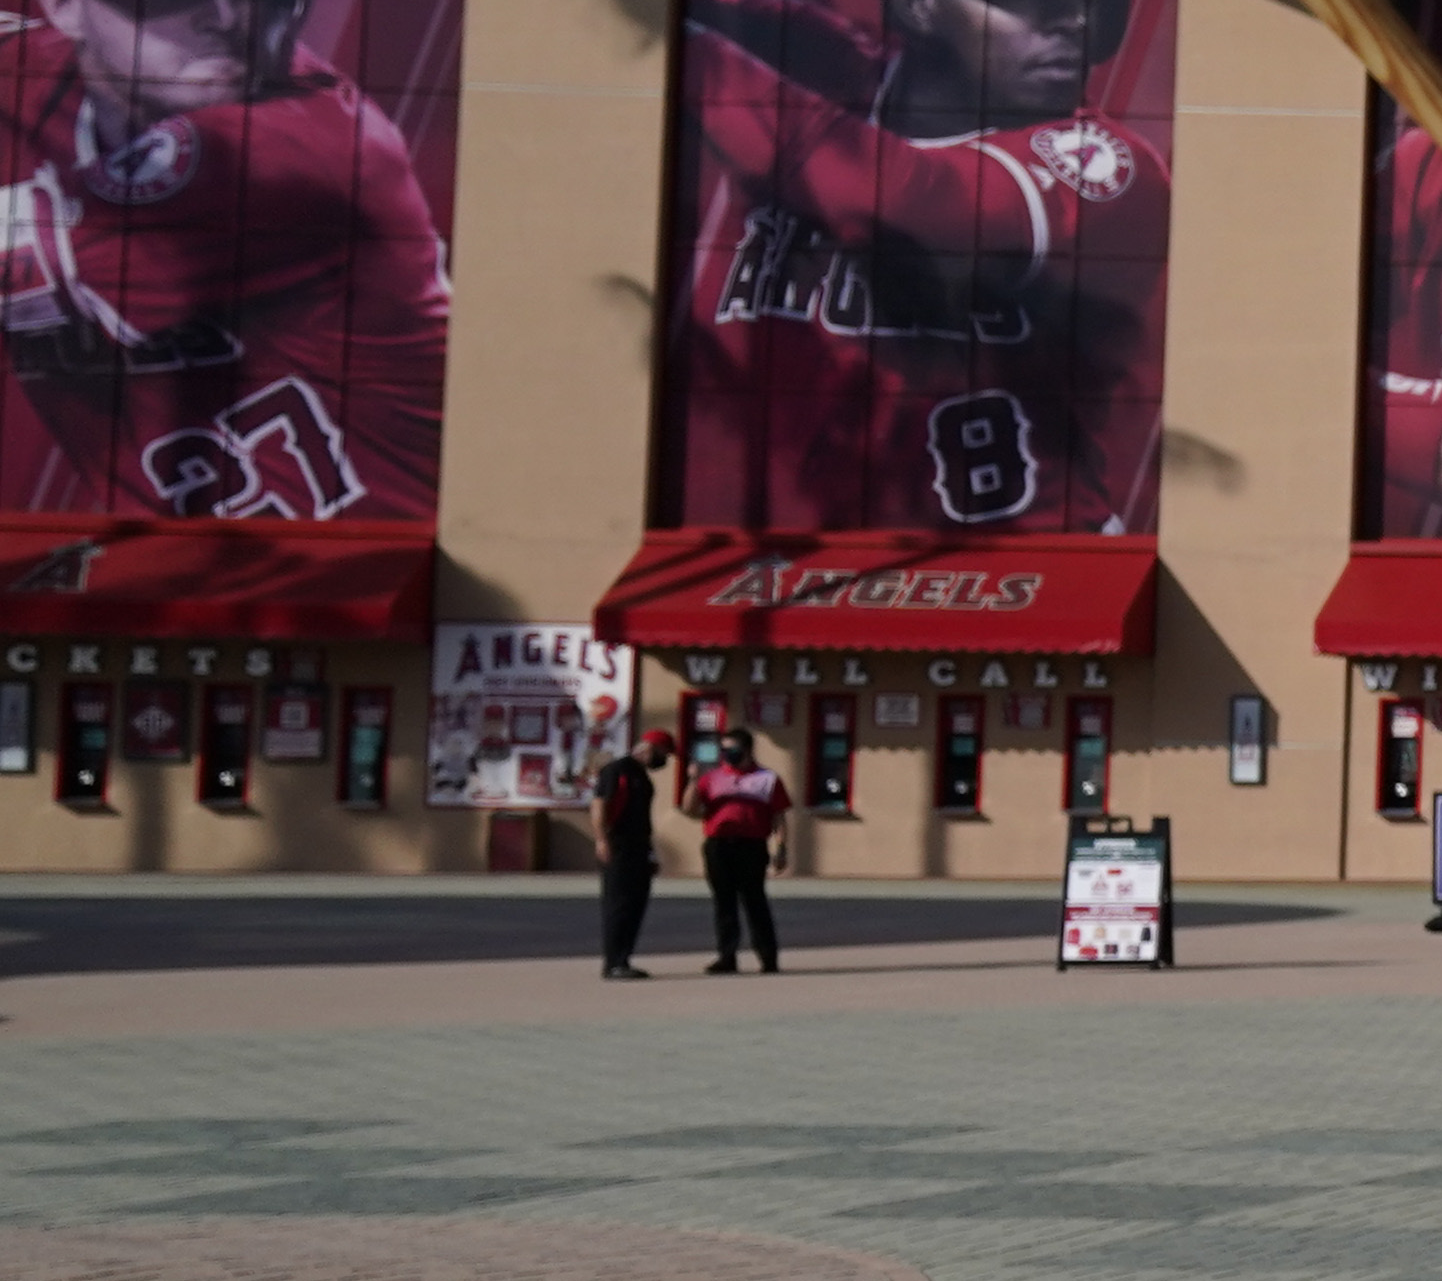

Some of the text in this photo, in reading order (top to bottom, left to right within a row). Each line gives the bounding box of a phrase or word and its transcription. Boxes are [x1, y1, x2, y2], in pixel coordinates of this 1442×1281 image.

[928, 389, 1037, 523] 8
[709, 558, 1044, 612] ANGELS
[686, 656, 1110, 689] WILL CALL
